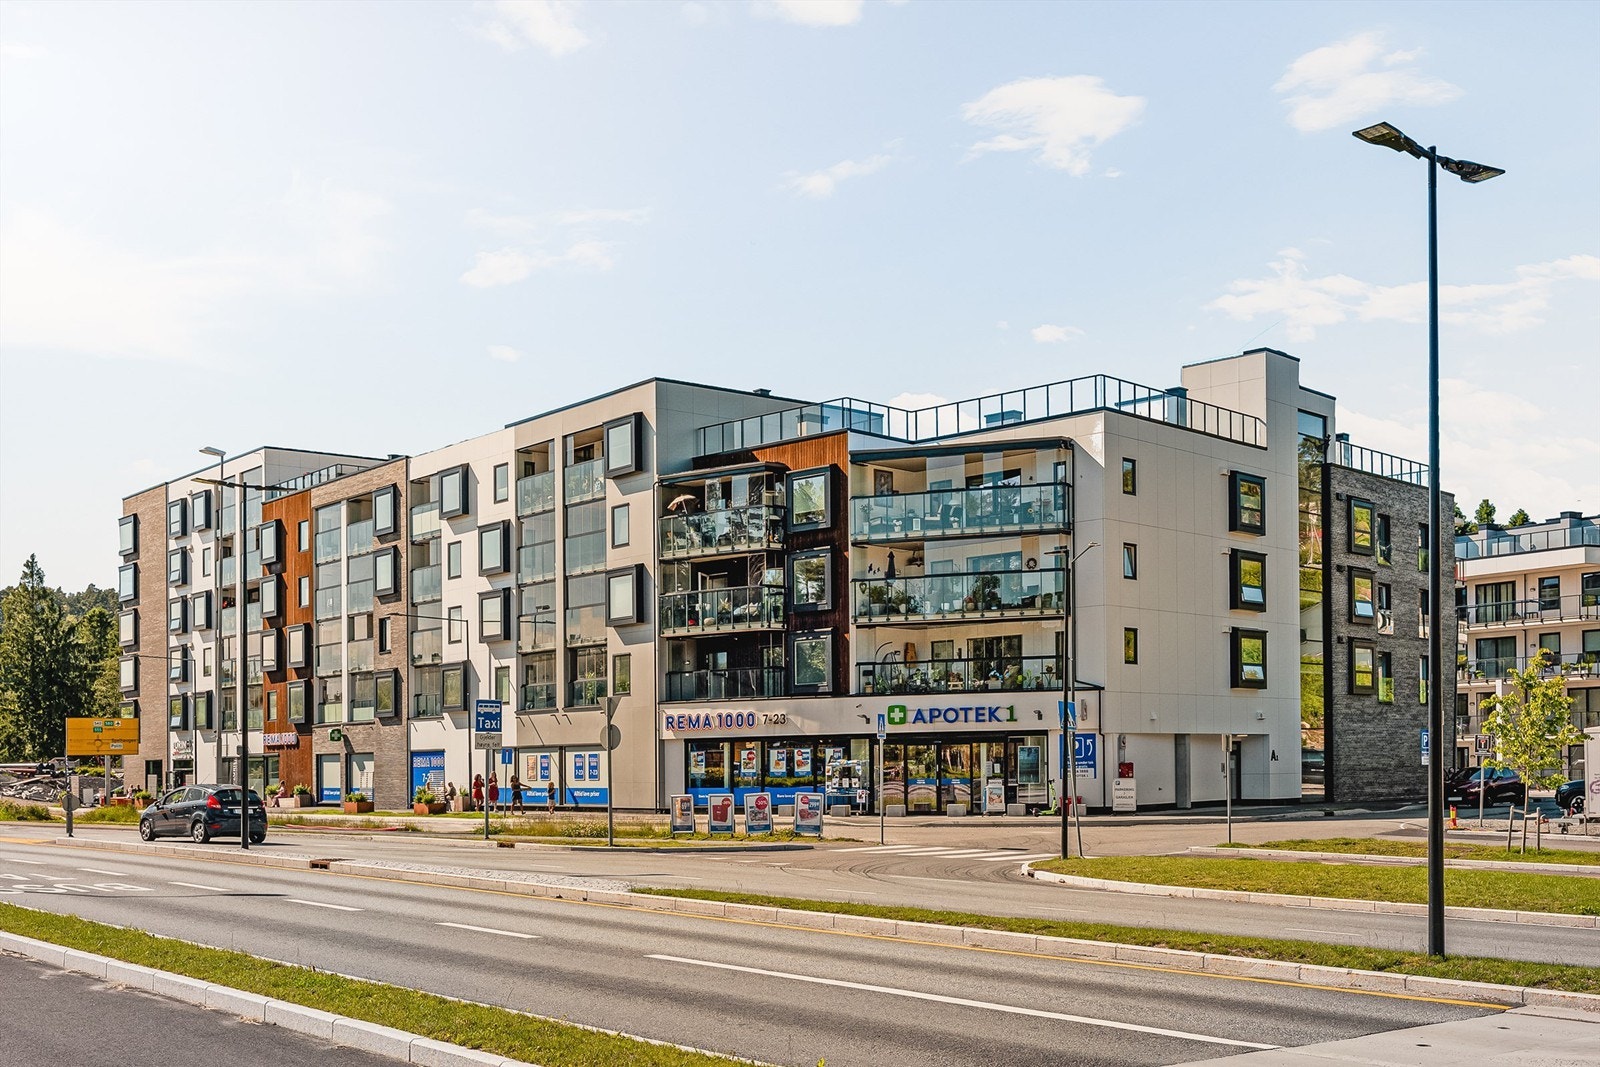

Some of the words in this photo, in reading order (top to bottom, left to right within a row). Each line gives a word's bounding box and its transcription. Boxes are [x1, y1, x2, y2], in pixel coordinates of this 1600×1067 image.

[665, 713, 714, 731] REMA
[716, 710, 757, 729] 1000
[762, 713, 787, 725] 7-23
[912, 706, 1003, 724] APOTEK
[1005, 705, 1018, 722] 1
[478, 717, 500, 728] Taxi
[263, 734, 280, 746] REMA
